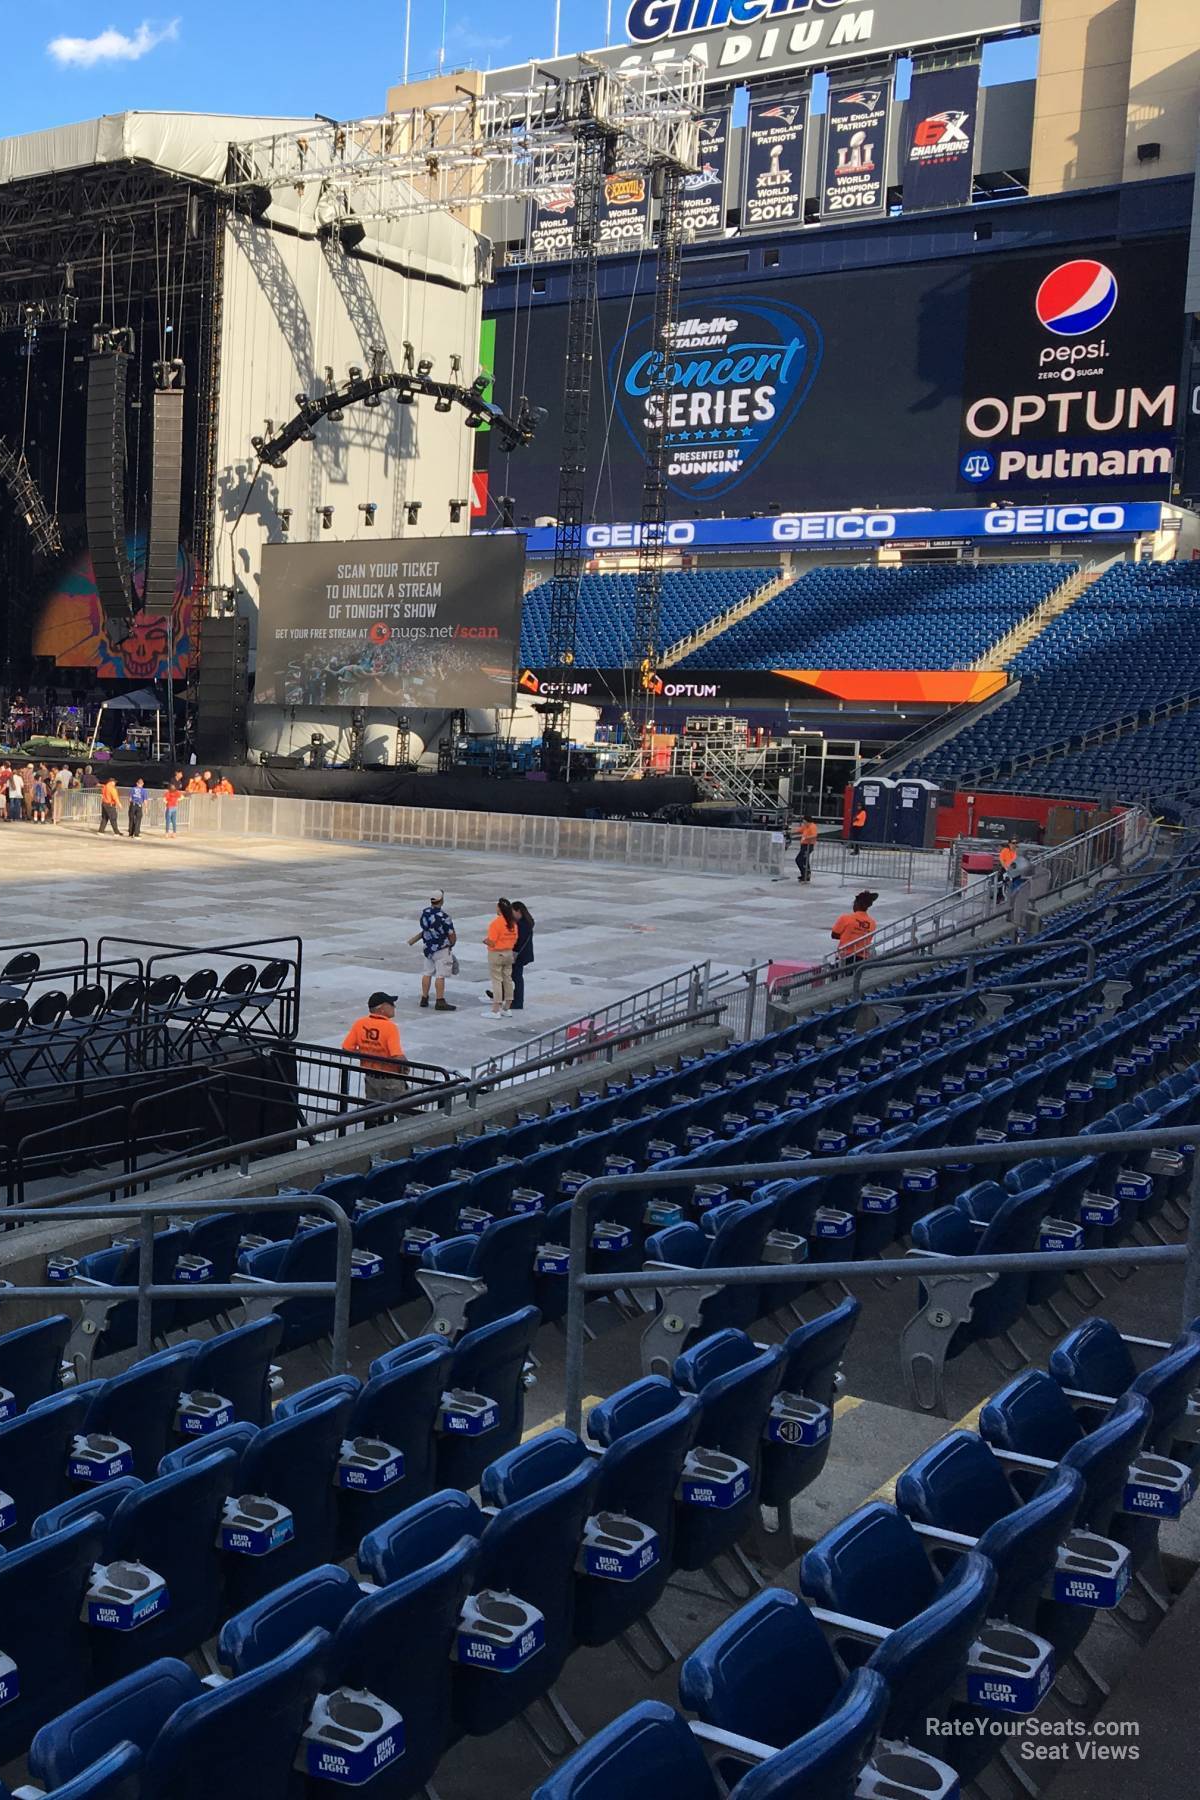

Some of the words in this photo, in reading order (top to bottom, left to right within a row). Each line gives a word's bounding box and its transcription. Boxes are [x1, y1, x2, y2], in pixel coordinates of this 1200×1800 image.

[626, 0, 845, 43] Gille
[850, 110, 885, 121] ENGLAND
[752, 130, 769, 138] NEW
[770, 124, 803, 135] ENGLAND
[836, 119, 878, 132] PATRIOTS
[757, 132, 797, 145] PATRIOTS
[910, 140, 970, 156] CHAMPIONS
[756, 172, 793, 187] XLIX
[837, 174, 871, 185] WORLD
[757, 187, 790, 197] WORLD
[826, 182, 880, 196] CHAMPIONS
[748, 194, 799, 207] CHAMPIONS
[829, 191, 876, 210] 2016
[609, 208, 638, 218] WORLD
[750, 203, 794, 221] 2014
[540, 219, 568, 229] WORLD
[600, 215, 645, 228] CHAMPIONS
[532, 226, 574, 238] CHAMPION
[600, 224, 644, 240] 2003
[534, 234, 573, 250] 2001
[661, 317, 739, 337] Gillette
[624, 338, 805, 396] Concert
[1038, 371, 1060, 380] ZERO
[1076, 367, 1104, 377] SUGAR
[643, 385, 776, 428] SERIES
[966, 385, 1176, 438] OPTUM
[674, 450, 725, 462] PRESENTED
[727, 449, 740, 459] BY
[668, 460, 744, 475] DUNKIN'
[999, 447, 1172, 481] Putnam
[984, 506, 1125, 534] GEICO
[772, 514, 896, 540] GEICO
[586, 523, 695, 547] GEICO
[337, 564, 367, 579] SCAN
[369, 563, 399, 578] YOUR
[402, 562, 440, 577] TICKET
[326, 584, 339, 599] TO
[342, 584, 384, 599] UNLOCK
[387, 583, 395, 598] A
[398, 582, 442, 598] STREAM
[329, 604, 342, 619] OF
[345, 603, 400, 619] TONIGHT'S
[403, 603, 437, 618] SHOW
[275, 629, 288, 639] GET
[290, 629, 308, 639] YOUR
[310, 629, 327, 639] FREE
[329, 629, 356, 639] STREAM
[358, 628, 368, 638] AT
[664, 684, 716, 696] OPTUM
[935, 1313, 944, 1324] 5
[108, 1464, 123, 1476] LIGHT
[110, 1460, 122, 1469] BUD
[73, 1468, 93, 1476] LIGHT
[346, 1477, 368, 1485] LIGHT
[691, 1493, 716, 1502] LIGHT
[1137, 1491, 1161, 1501] BUD
[1133, 1499, 1164, 1509] LIGHT
[230, 1540, 251, 1548] LIGHT
[232, 1534, 249, 1542] BUD
[595, 1562, 624, 1573] LIGHT
[599, 1556, 619, 1566] BUD
[1070, 1581, 1095, 1591] BUD
[1066, 1588, 1100, 1600] LIGHT
[96, 1613, 120, 1623] LIGHT
[99, 1608, 117, 1616] BUD
[521, 1630, 535, 1644] BUD
[470, 1642, 492, 1653] BUD
[519, 1638, 536, 1657] LIGHT
[466, 1649, 496, 1661] LIGHT
[984, 1683, 1012, 1694] BUD
[979, 1691, 1017, 1704] LIGHT
[376, 1736, 394, 1754] BUD
[323, 1753, 346, 1765] BUD
[373, 1745, 396, 1767] LIGHT
[318, 1761, 350, 1775] LIGHT
